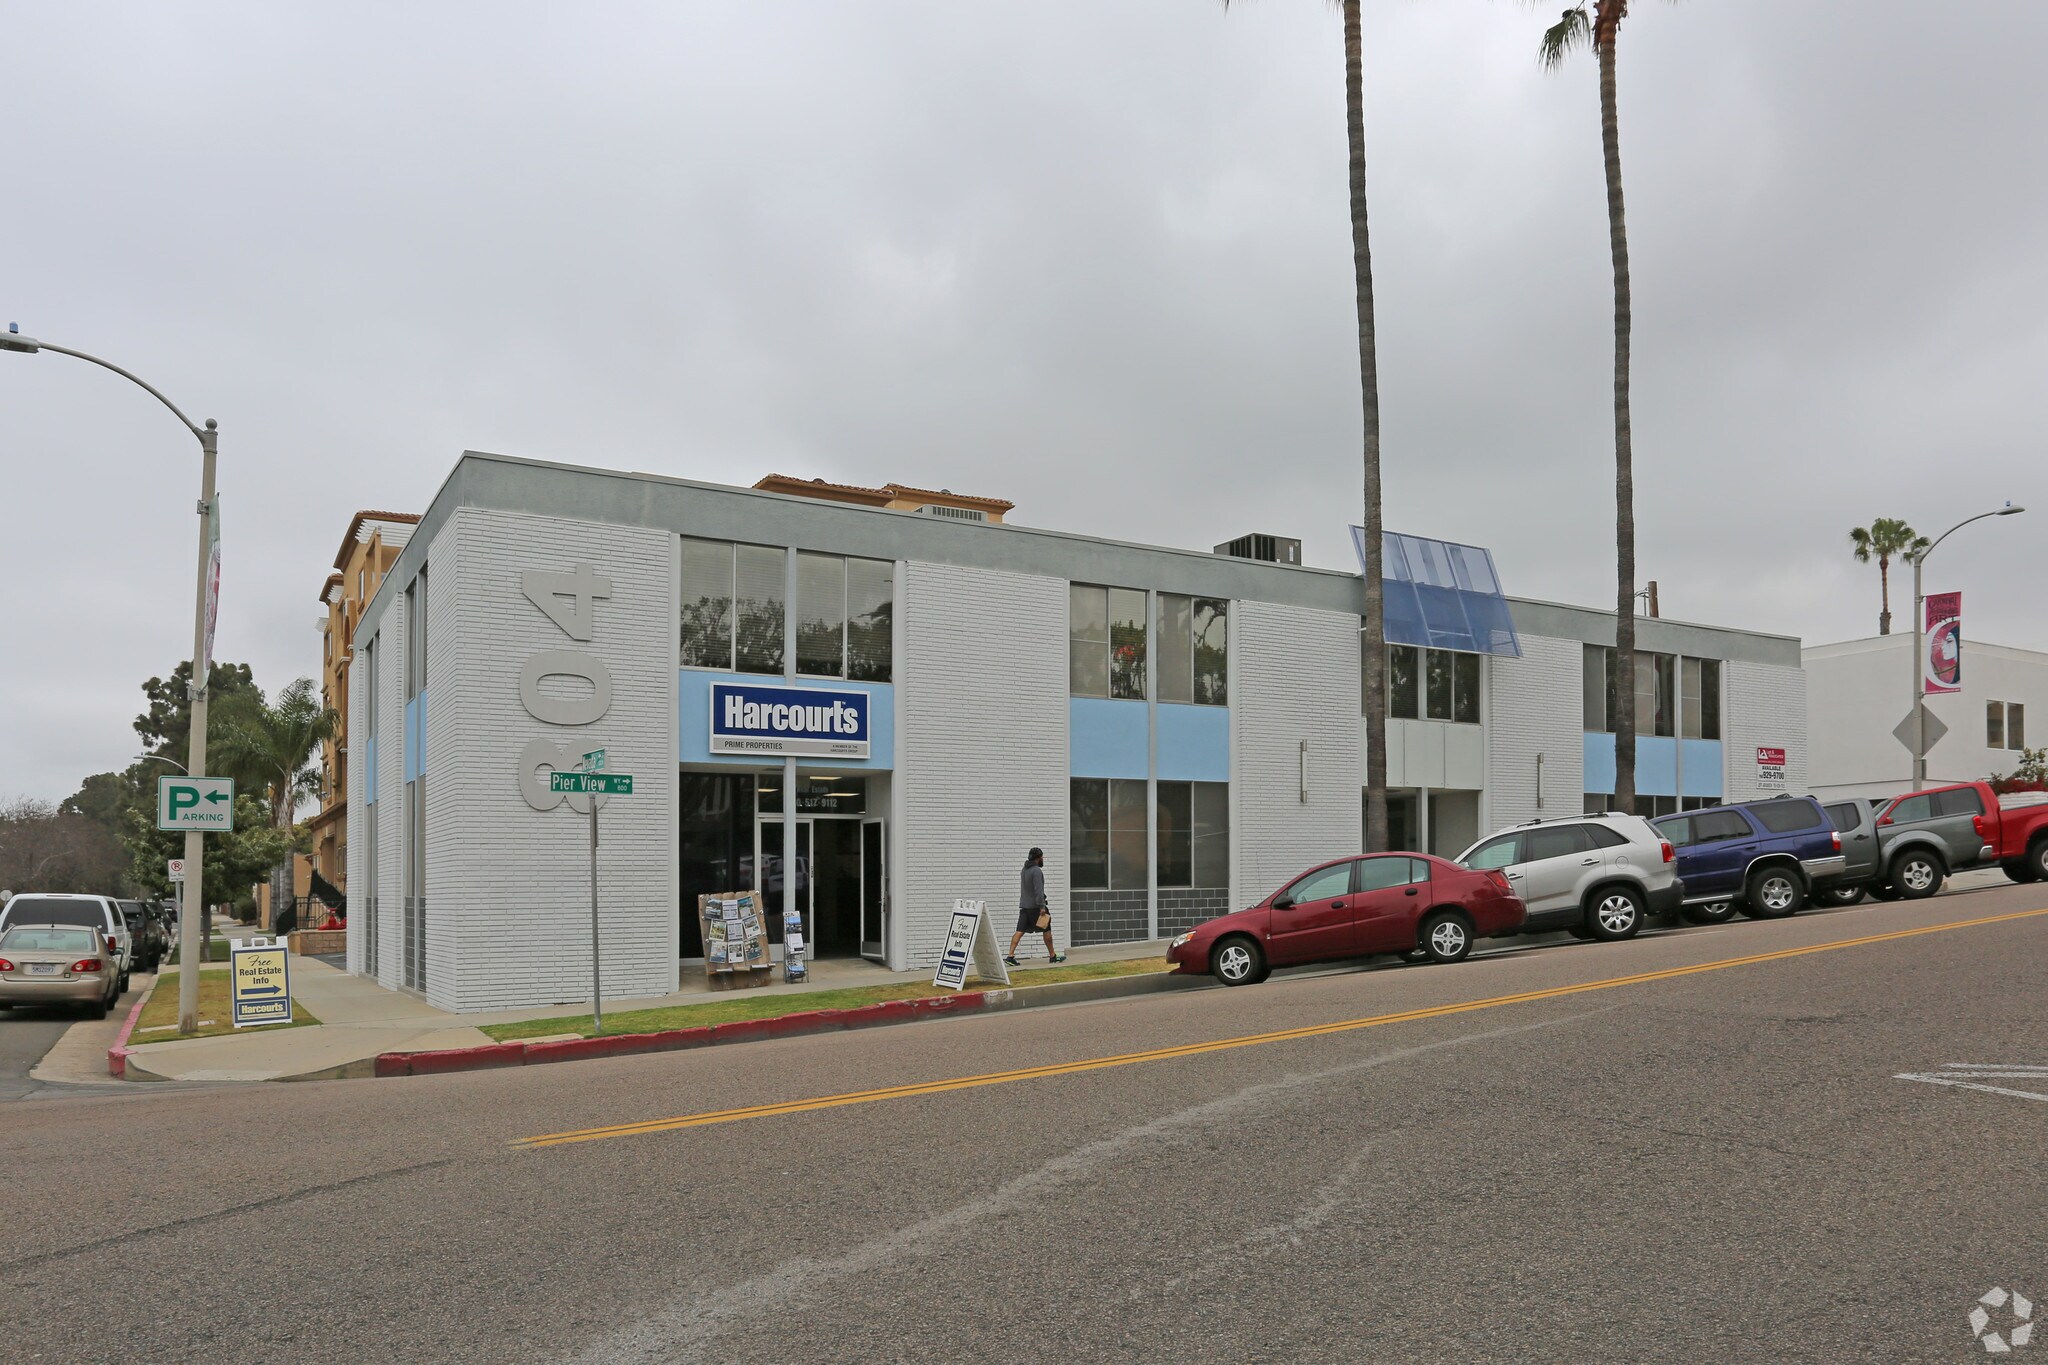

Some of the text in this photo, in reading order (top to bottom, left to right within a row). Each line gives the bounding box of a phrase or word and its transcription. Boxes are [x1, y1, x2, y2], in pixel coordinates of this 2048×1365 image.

[724, 695, 859, 734] Harcourts
[724, 740, 783, 750] PRIME PROPERTIES
[552, 774, 575, 790] Pier
[580, 775, 606, 791] View
[169, 786, 224, 821] PARKING
[951, 930, 971, 940] Real Estate
[954, 940, 962, 948] Info
[248, 954, 273, 967] Free
[239, 967, 282, 976] Real Estate
[241, 1003, 284, 1014] Harcourts
